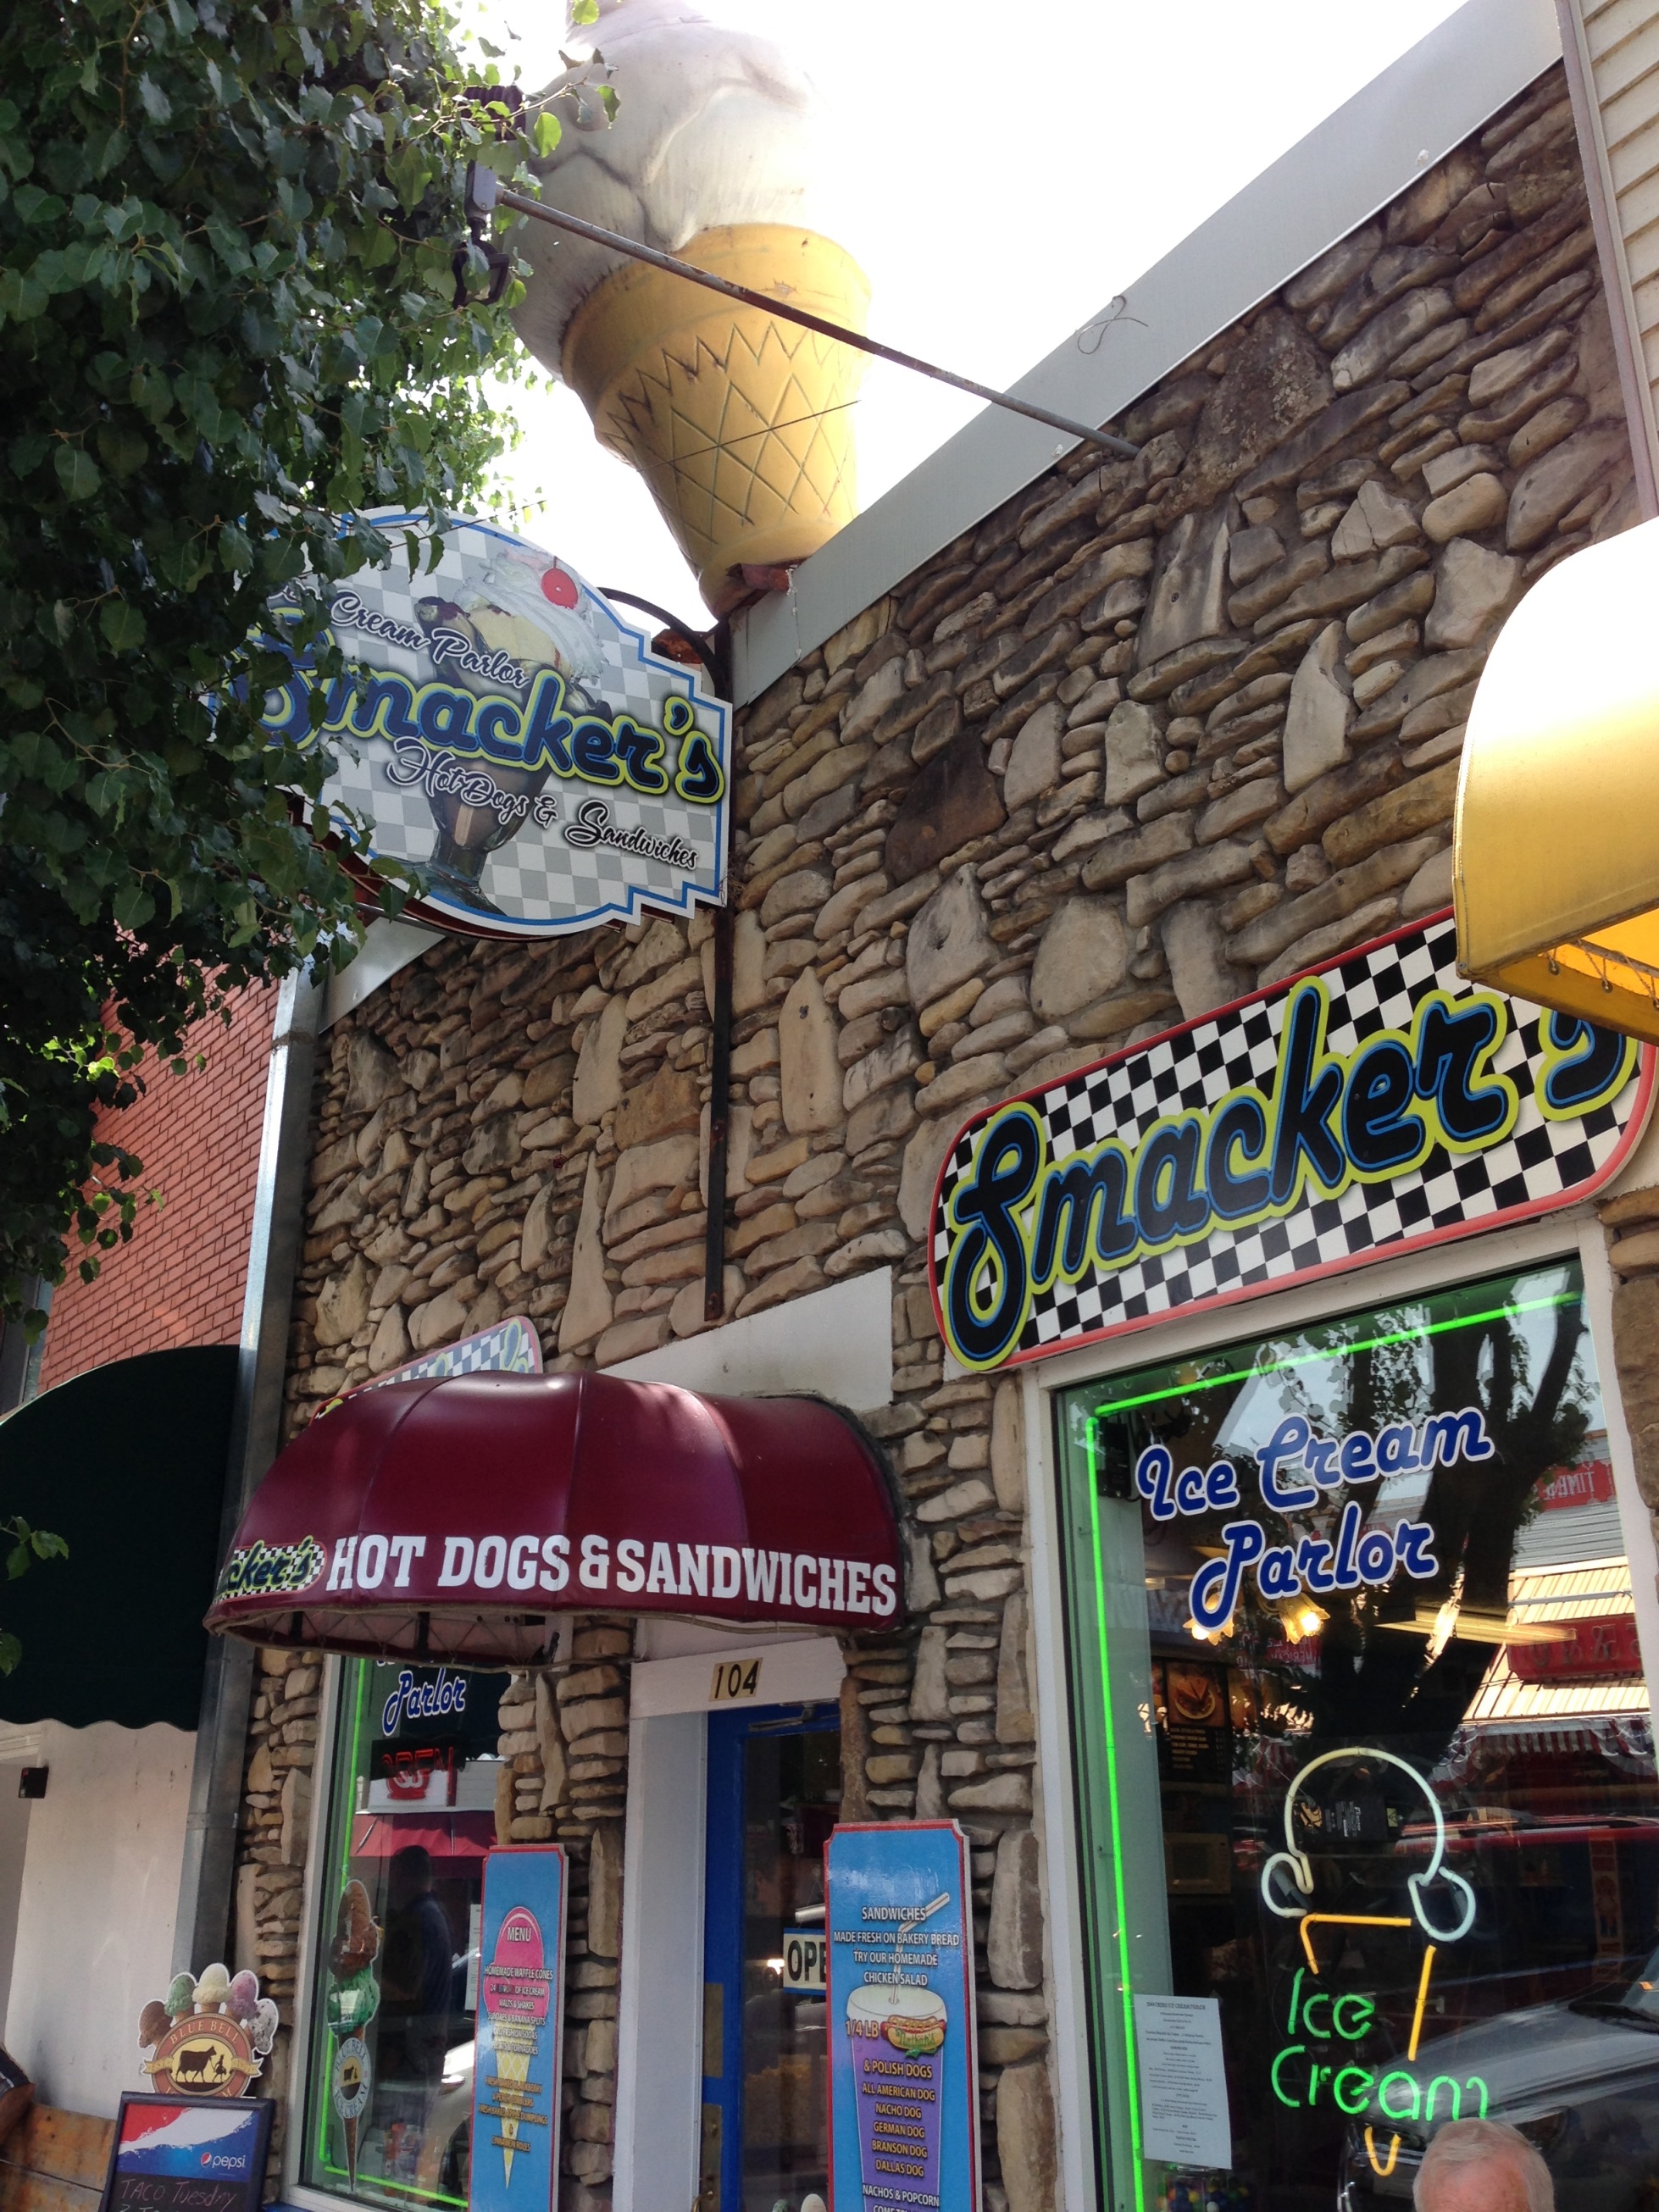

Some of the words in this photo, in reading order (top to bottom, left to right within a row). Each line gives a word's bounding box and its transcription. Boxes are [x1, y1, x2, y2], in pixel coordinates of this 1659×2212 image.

[330, 591, 430, 650] Cream
[430, 628, 531, 689] Parlor
[386, 736, 463, 798] Hot
[462, 773, 526, 826] Dogs
[534, 791, 558, 828] &
[564, 801, 698, 870] Sandwiches
[942, 975, 1639, 1372] Smackers
[1136, 1444, 1240, 1522] Ice
[1255, 1406, 1495, 1513] Cream
[227, 1535, 313, 1591] cker's
[325, 1535, 424, 1592] HOT
[437, 1533, 570, 1591] DOGS
[580, 1534, 608, 1589] &
[615, 1539, 896, 1617] SANDWICHES
[1188, 1500, 1440, 1633] Parlor
[714, 1660, 759, 1699] 104
[382, 1667, 466, 1737] Parlor
[862, 1906, 926, 1921] SANDWICHES
[507, 1926, 531, 1942] MENU
[834, 1932, 856, 1943] MADE
[857, 1932, 881, 1944] FRESH
[883, 1932, 896, 1944] ON
[897, 1932, 929, 1945] BAKERY
[931, 1934, 959, 1946] BREAD
[788, 1940, 827, 1983] OPE
[853, 1951, 868, 1964] TRY
[869, 1952, 887, 1964] OUR
[889, 1953, 938, 1966] HOMEMADE
[484, 1965, 514, 1976] HOMEMADE
[535, 1969, 553, 1980] CONES
[863, 1971, 899, 1984] CHICKEN
[900, 1972, 928, 1985] SALAD
[529, 1987, 545, 1997] CREAM
[517, 2000, 535, 2010] SHAKES
[1287, 1967, 1374, 2040] Ice
[169, 2021, 204, 2044] BLUE
[210, 2021, 239, 2044] BELL
[846, 2020, 863, 2037] 1/4
[865, 2021, 879, 2037] LB
[863, 2060, 870, 2071] &
[872, 2060, 904, 2076] POLISH
[906, 2063, 933, 2079] DOGS
[862, 2082, 875, 2094] ALL
[876, 2084, 916, 2098] AMERICAN
[918, 2089, 935, 2102] DOG
[1271, 2045, 1489, 2121] Cream
[875, 2103, 902, 2116] NACHO
[904, 2106, 922, 2119] DOG
[873, 2121, 906, 2136] GERMAN
[907, 2126, 925, 2138] DOG
[872, 2140, 908, 2155] BRANSON
[909, 2144, 928, 2159] DOG
[212, 2155, 246, 2170] pepsi
[875, 2159, 905, 2174] DALLAS
[907, 2164, 924, 2177] DOG
[120, 2178, 166, 2202] TACO
[172, 2181, 238, 2212] Tuesday
[863, 2184, 893, 2199] NACHOS
[895, 2190, 901, 2201] &
[902, 2191, 940, 2207] POPCORN
